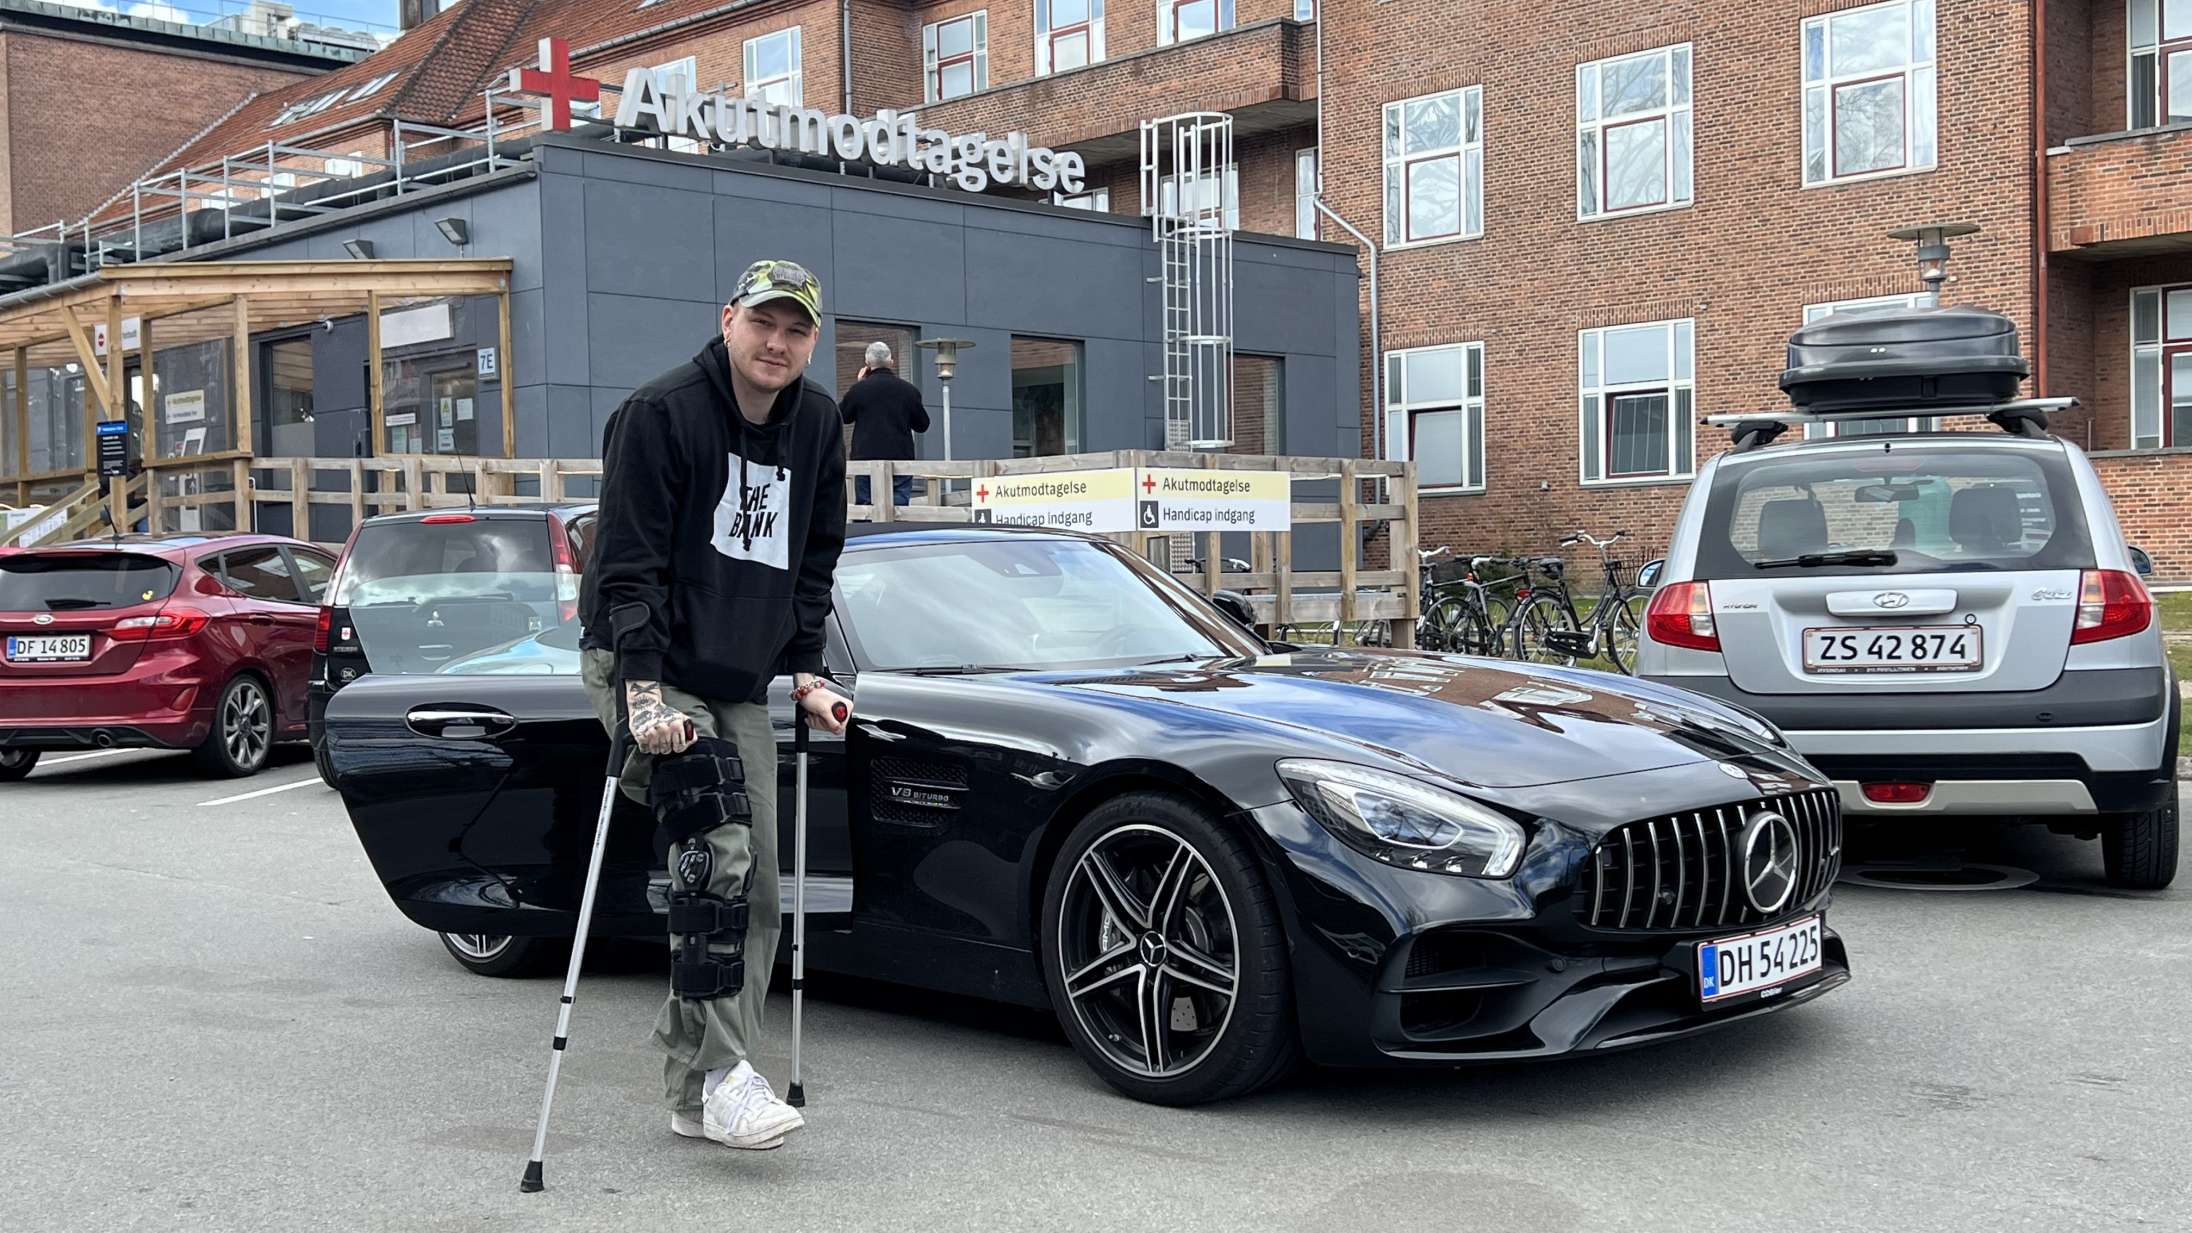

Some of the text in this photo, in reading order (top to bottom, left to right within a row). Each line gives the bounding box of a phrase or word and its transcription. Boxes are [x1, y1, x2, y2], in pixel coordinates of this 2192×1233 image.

[617, 67, 1086, 194] Akutmodtagelse
[479, 353, 494, 370] 7E
[995, 480, 1087, 499] Akutmodtagelse
[1162, 477, 1250, 493] Akutmodtagelse
[995, 511, 1093, 526] Handicap indgang
[1162, 507, 1256, 524] Handicap indgang
[17, 640, 36, 654] DF
[41, 639, 57, 653] 14
[60, 638, 86, 653] 805
[1820, 634, 1966, 660] ZS 42 874
[891, 786, 949, 801] V8 BITURBO
[1720, 925, 1818, 988] DH 54 225
[1703, 976, 1715, 989] DK
